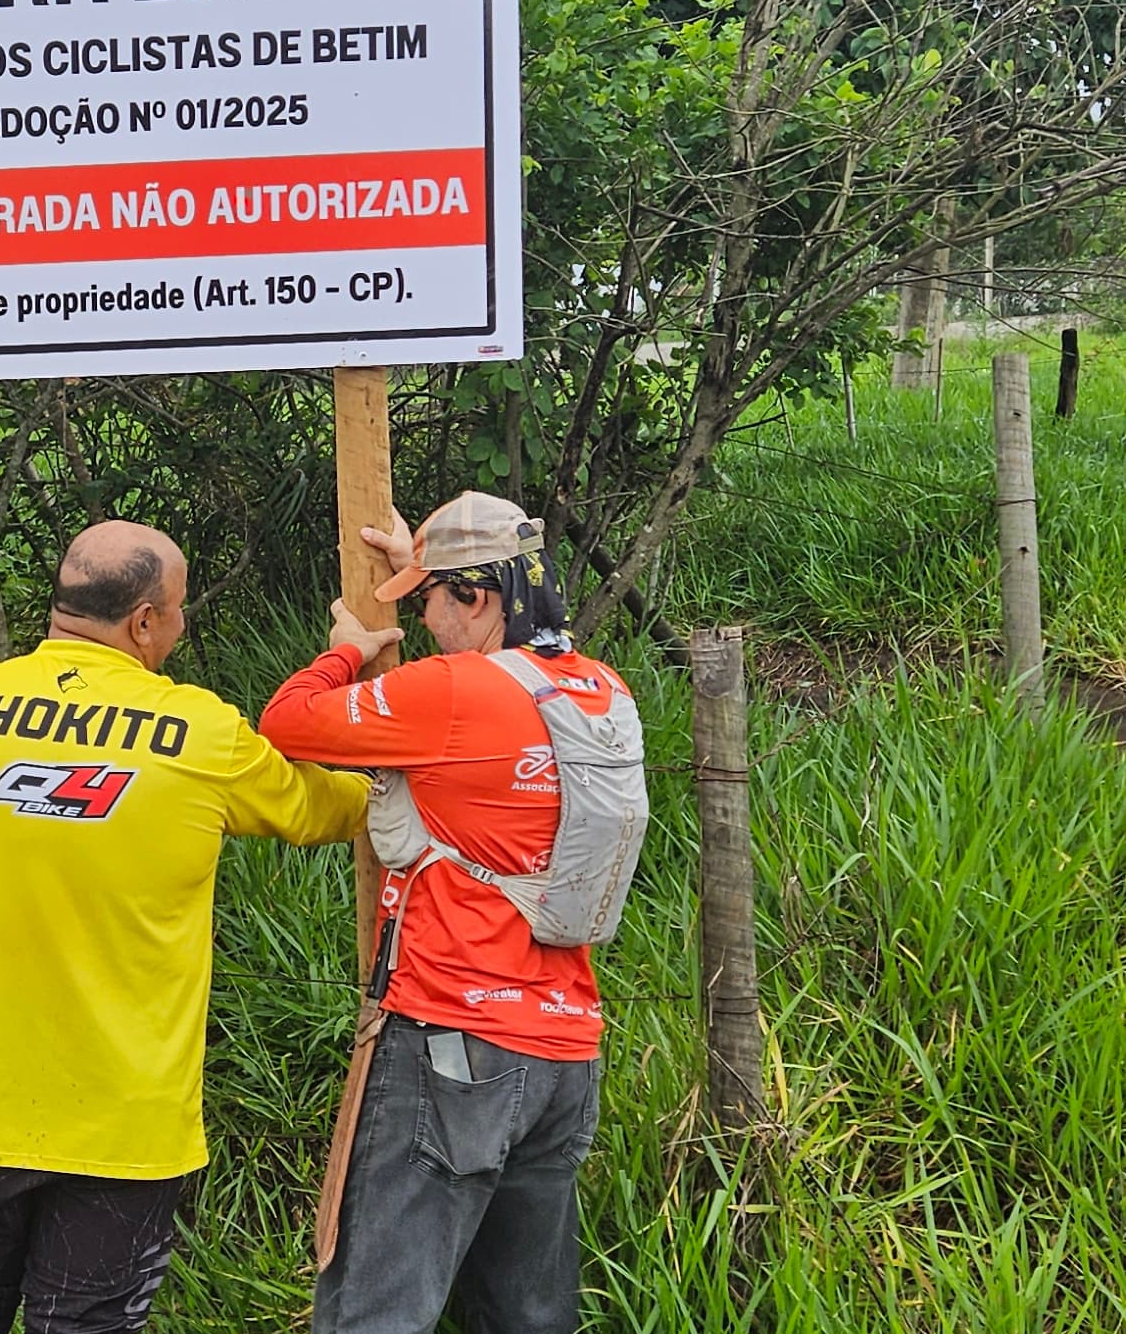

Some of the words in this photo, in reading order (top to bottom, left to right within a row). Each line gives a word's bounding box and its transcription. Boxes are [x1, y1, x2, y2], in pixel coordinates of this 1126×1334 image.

[43, 32, 242, 76] CICLISTAS
[253, 30, 302, 66] DE
[312, 24, 427, 64] BETIM
[176, 94, 309, 131] 01/2025
[111, 182, 196, 229] NÃO
[207, 176, 470, 225] AUTORIZADA
[17, 281, 185, 322] propriedade
[193, 275, 257, 312] (Art.
[264, 274, 316, 305] 150
[349, 267, 413, 303] CP).
[22, 801, 83, 817] BIKE
